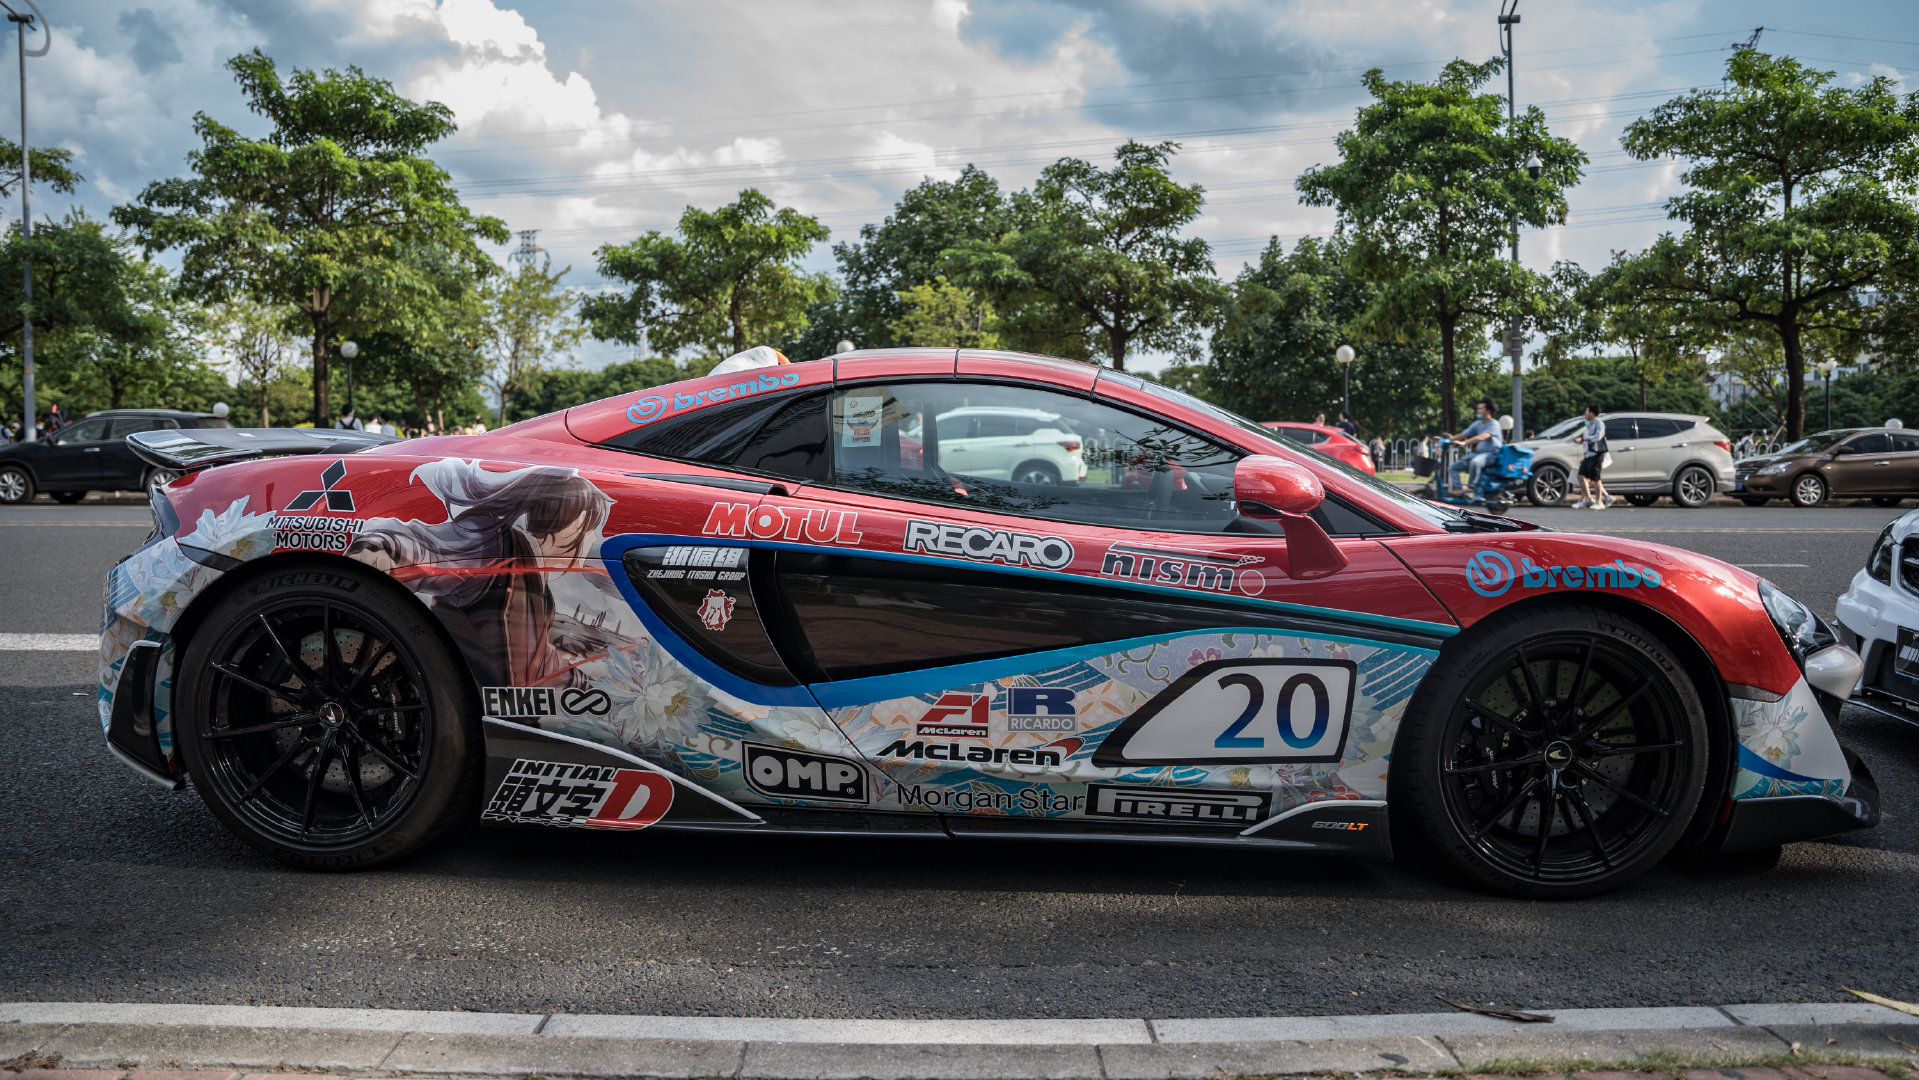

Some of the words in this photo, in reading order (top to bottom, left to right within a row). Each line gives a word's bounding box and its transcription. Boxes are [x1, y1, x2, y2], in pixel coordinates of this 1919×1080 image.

[673, 373, 800, 411] brembo
[264, 516, 364, 534] MITSUBISHI
[702, 502, 863, 545] MOTUL
[275, 531, 347, 550] MOTORS
[904, 519, 1074, 569] RECARO
[257, 574, 354, 593] MICHELIN
[647, 569, 686, 579] ZHEJIANG
[687, 570, 717, 580] ITASHA
[717, 571, 747, 581] GROUP
[1520, 557, 1662, 589] brembo
[483, 687, 557, 716] ENKEI
[1214, 672, 1330, 750] 20
[918, 726, 987, 737] McLaren
[1010, 717, 1074, 731] RICARDO
[875, 739, 1061, 767] McLaren
[510, 759, 613, 783] INITIAL
[752, 755, 859, 792] OMP
[583, 769, 675, 831] D
[897, 784, 1012, 812] Morgan
[1018, 788, 1086, 812] Star
[1097, 788, 1263, 821] PIRELLI
[1311, 821, 1369, 831] 600LT
